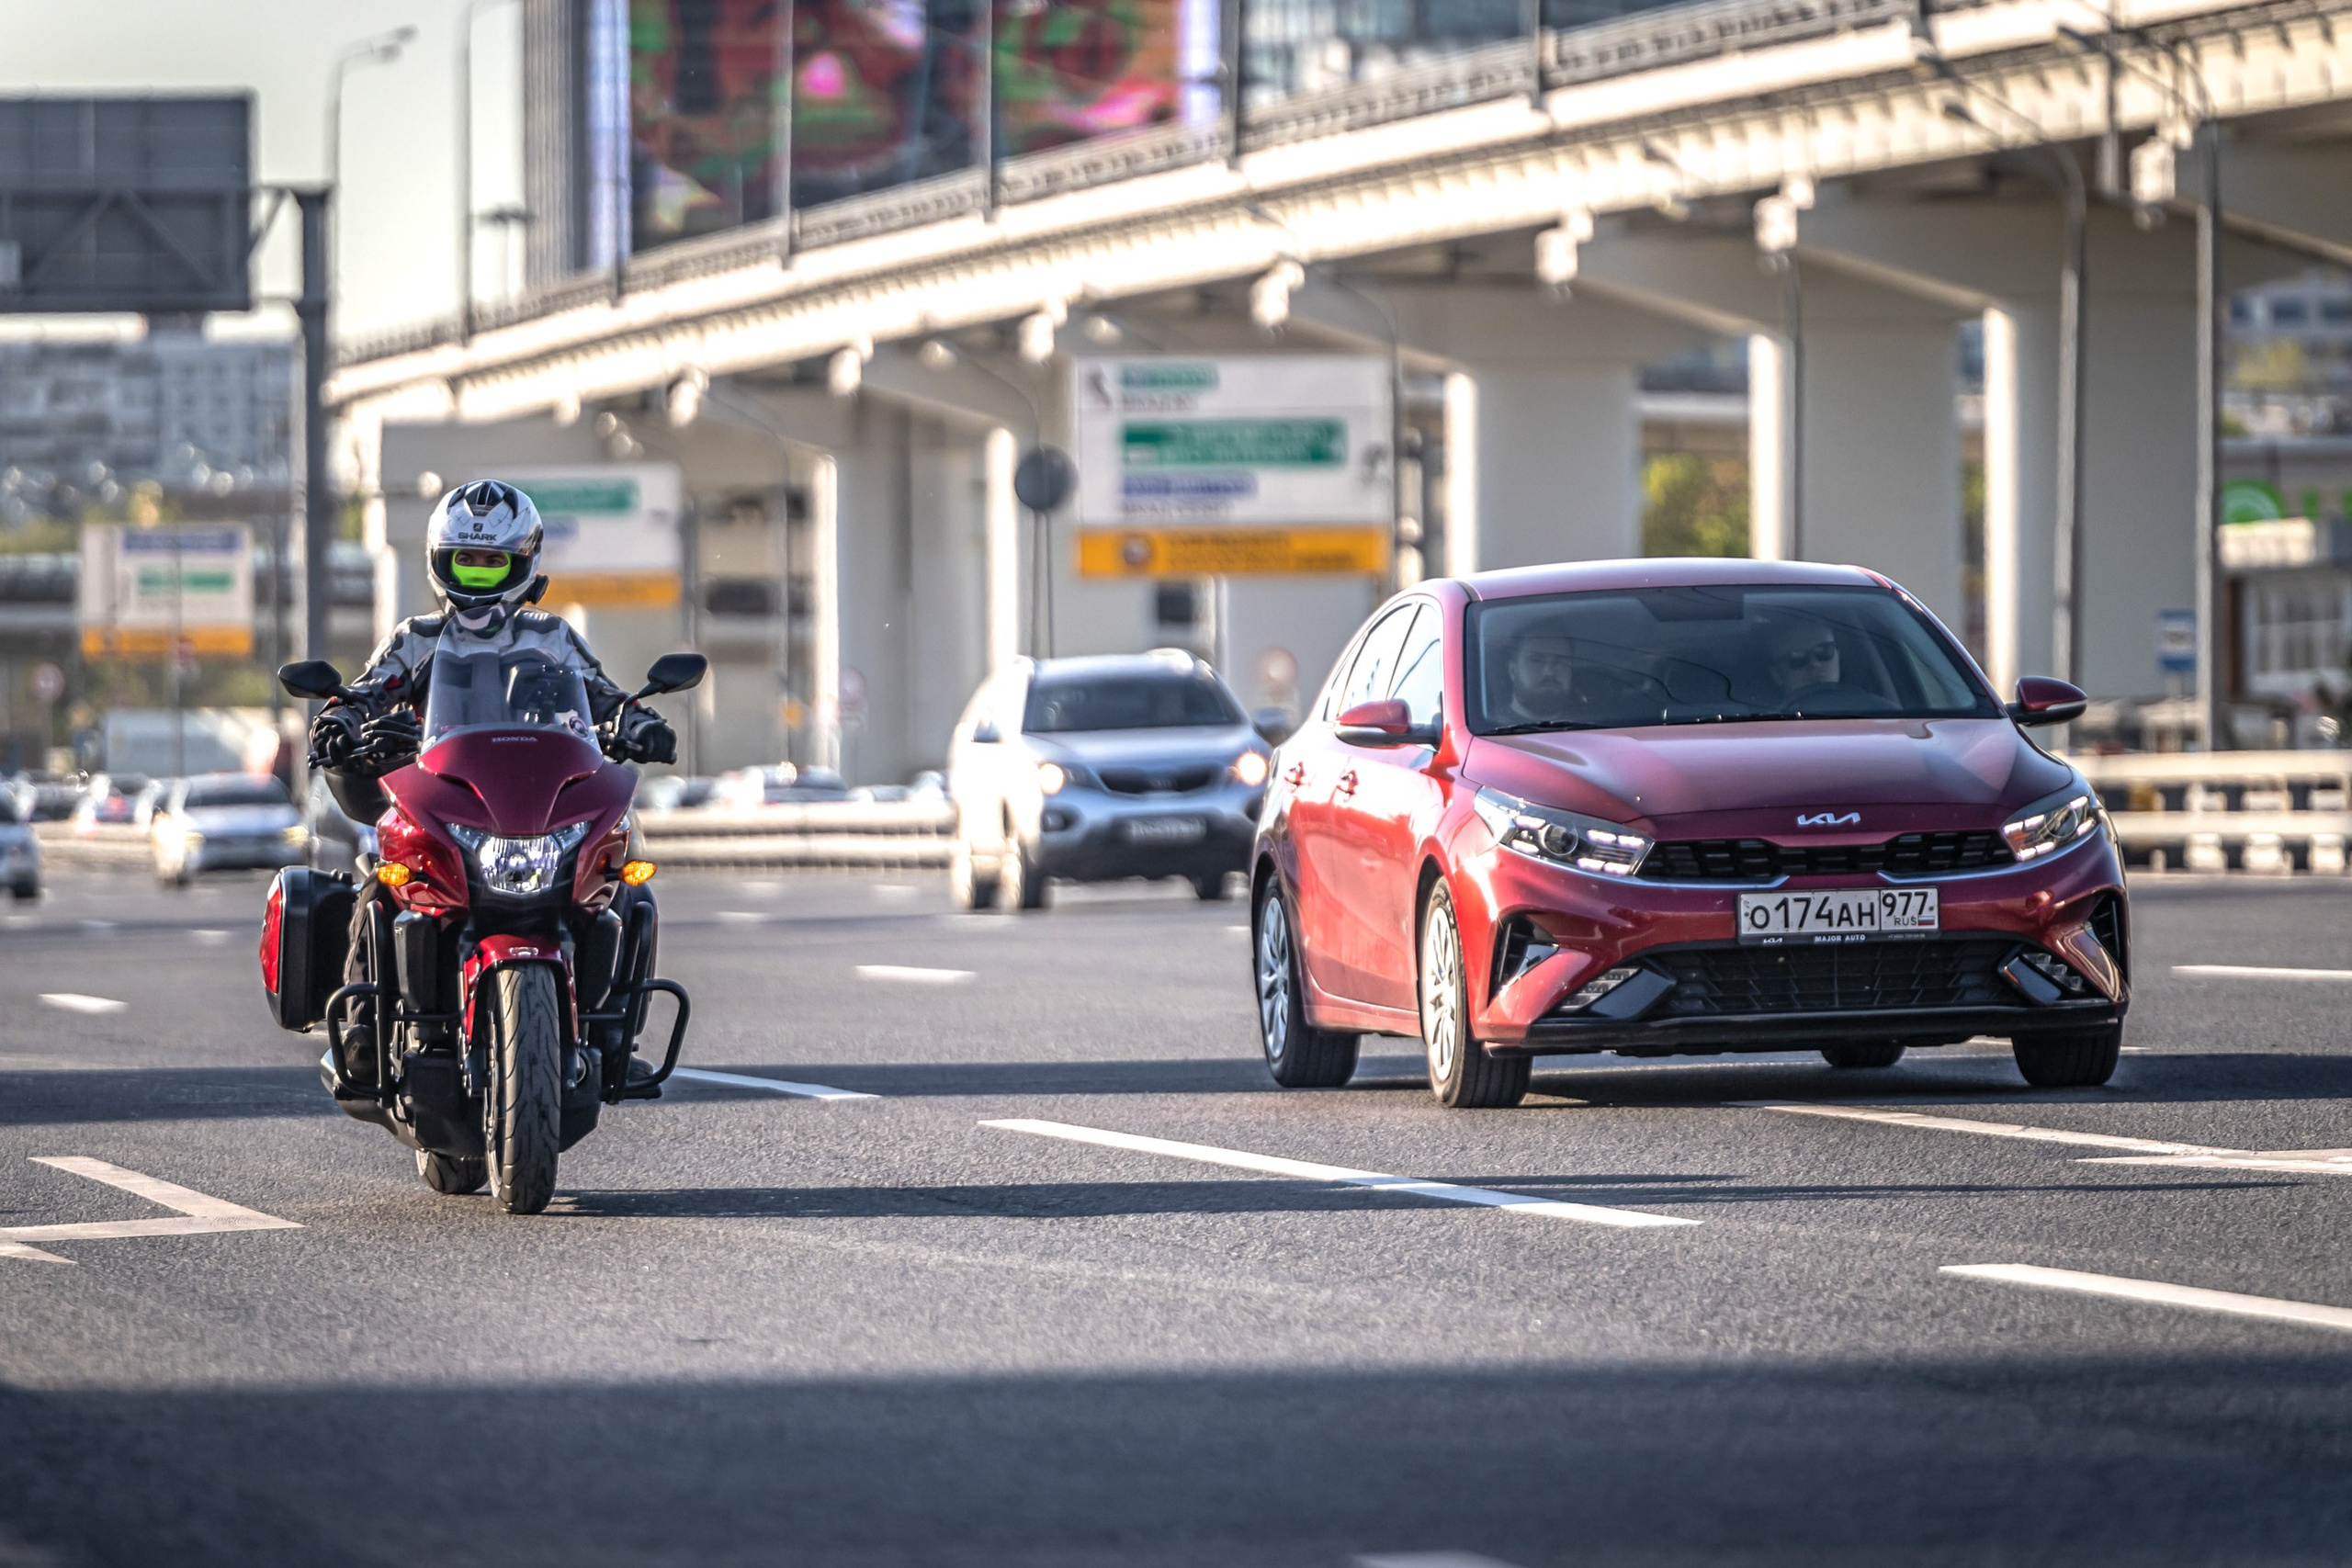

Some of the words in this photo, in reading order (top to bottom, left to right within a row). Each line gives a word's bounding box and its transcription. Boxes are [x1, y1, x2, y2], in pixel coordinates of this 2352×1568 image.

[458, 532, 497, 542] SHARK
[1882, 891, 1928, 917] 977
[1894, 916, 1917, 926] RUS
